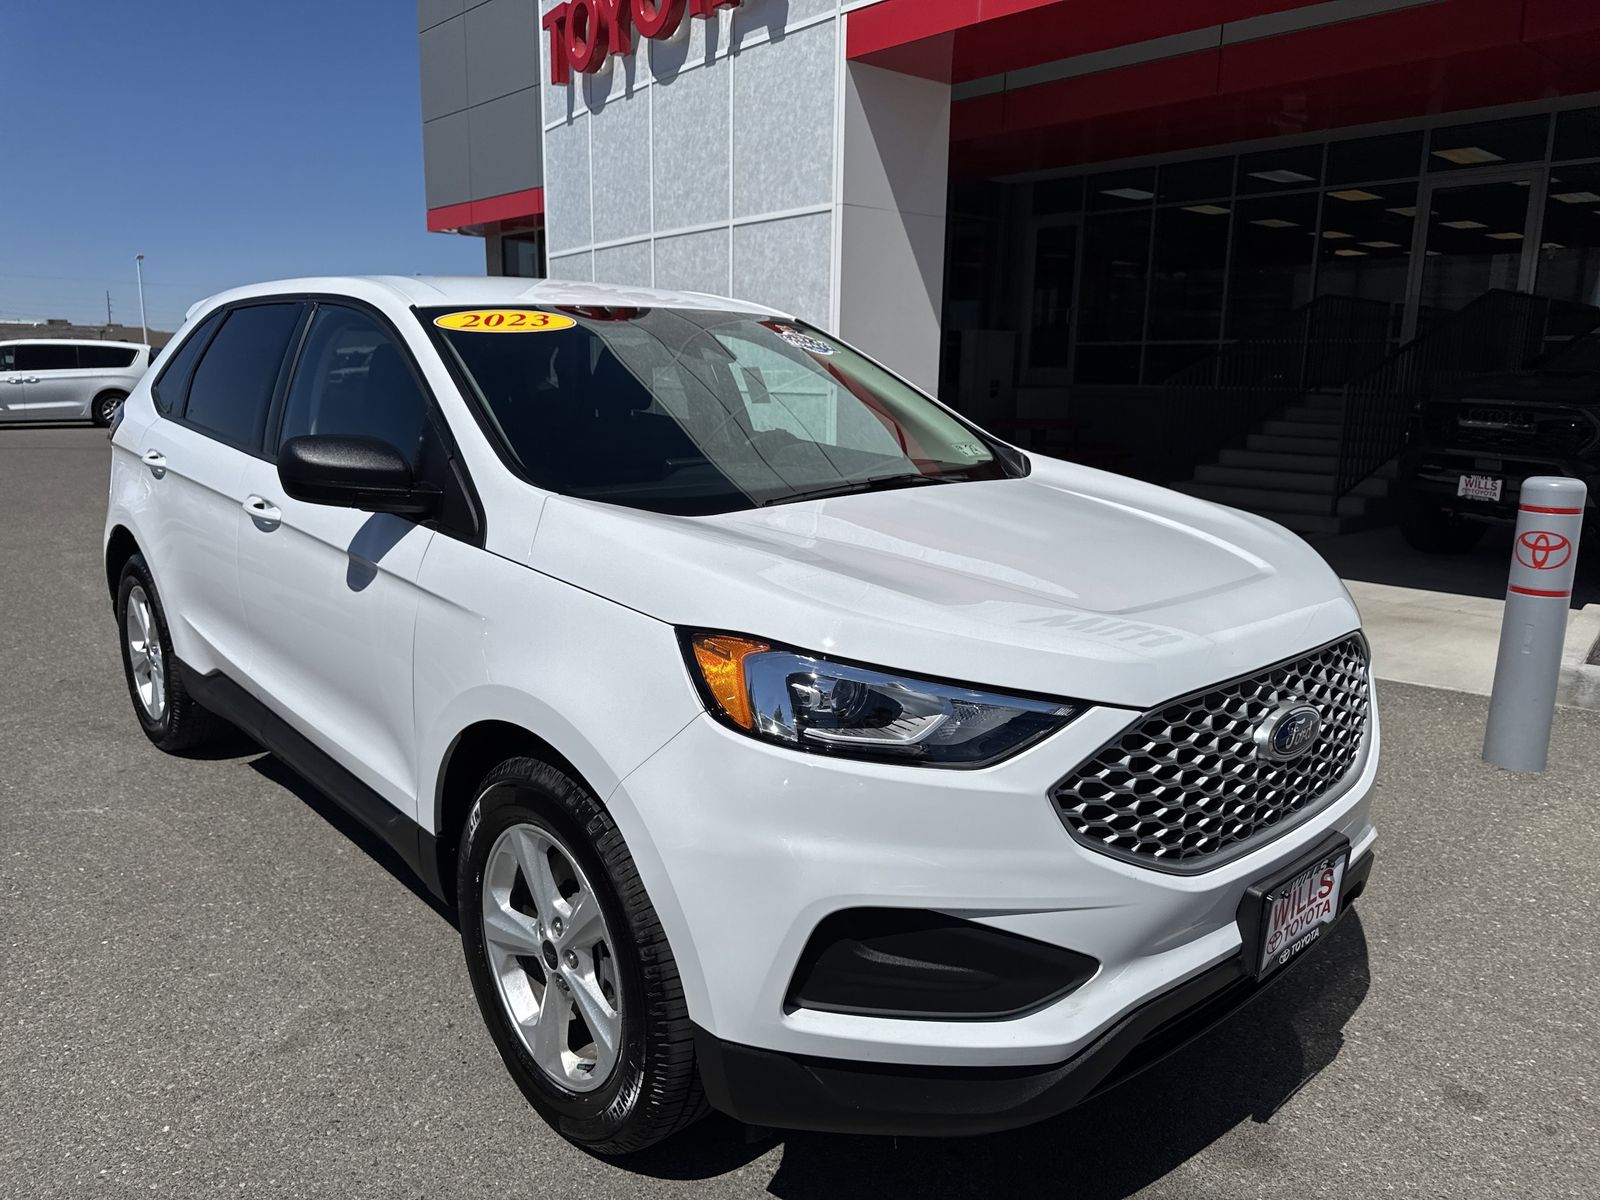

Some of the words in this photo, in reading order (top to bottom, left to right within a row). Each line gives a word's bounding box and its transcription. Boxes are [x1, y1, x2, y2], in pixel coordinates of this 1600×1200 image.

[543, 0, 743, 85] TOY
[460, 313, 549, 327] 2023
[1464, 479, 1497, 491] WILLS
[1472, 489, 1497, 497] TOYOTA
[1285, 717, 1313, 749] Ford
[1273, 868, 1334, 931] WILLS
[1284, 899, 1331, 941] TOYOTA
[1291, 927, 1320, 956] TOYOTA
